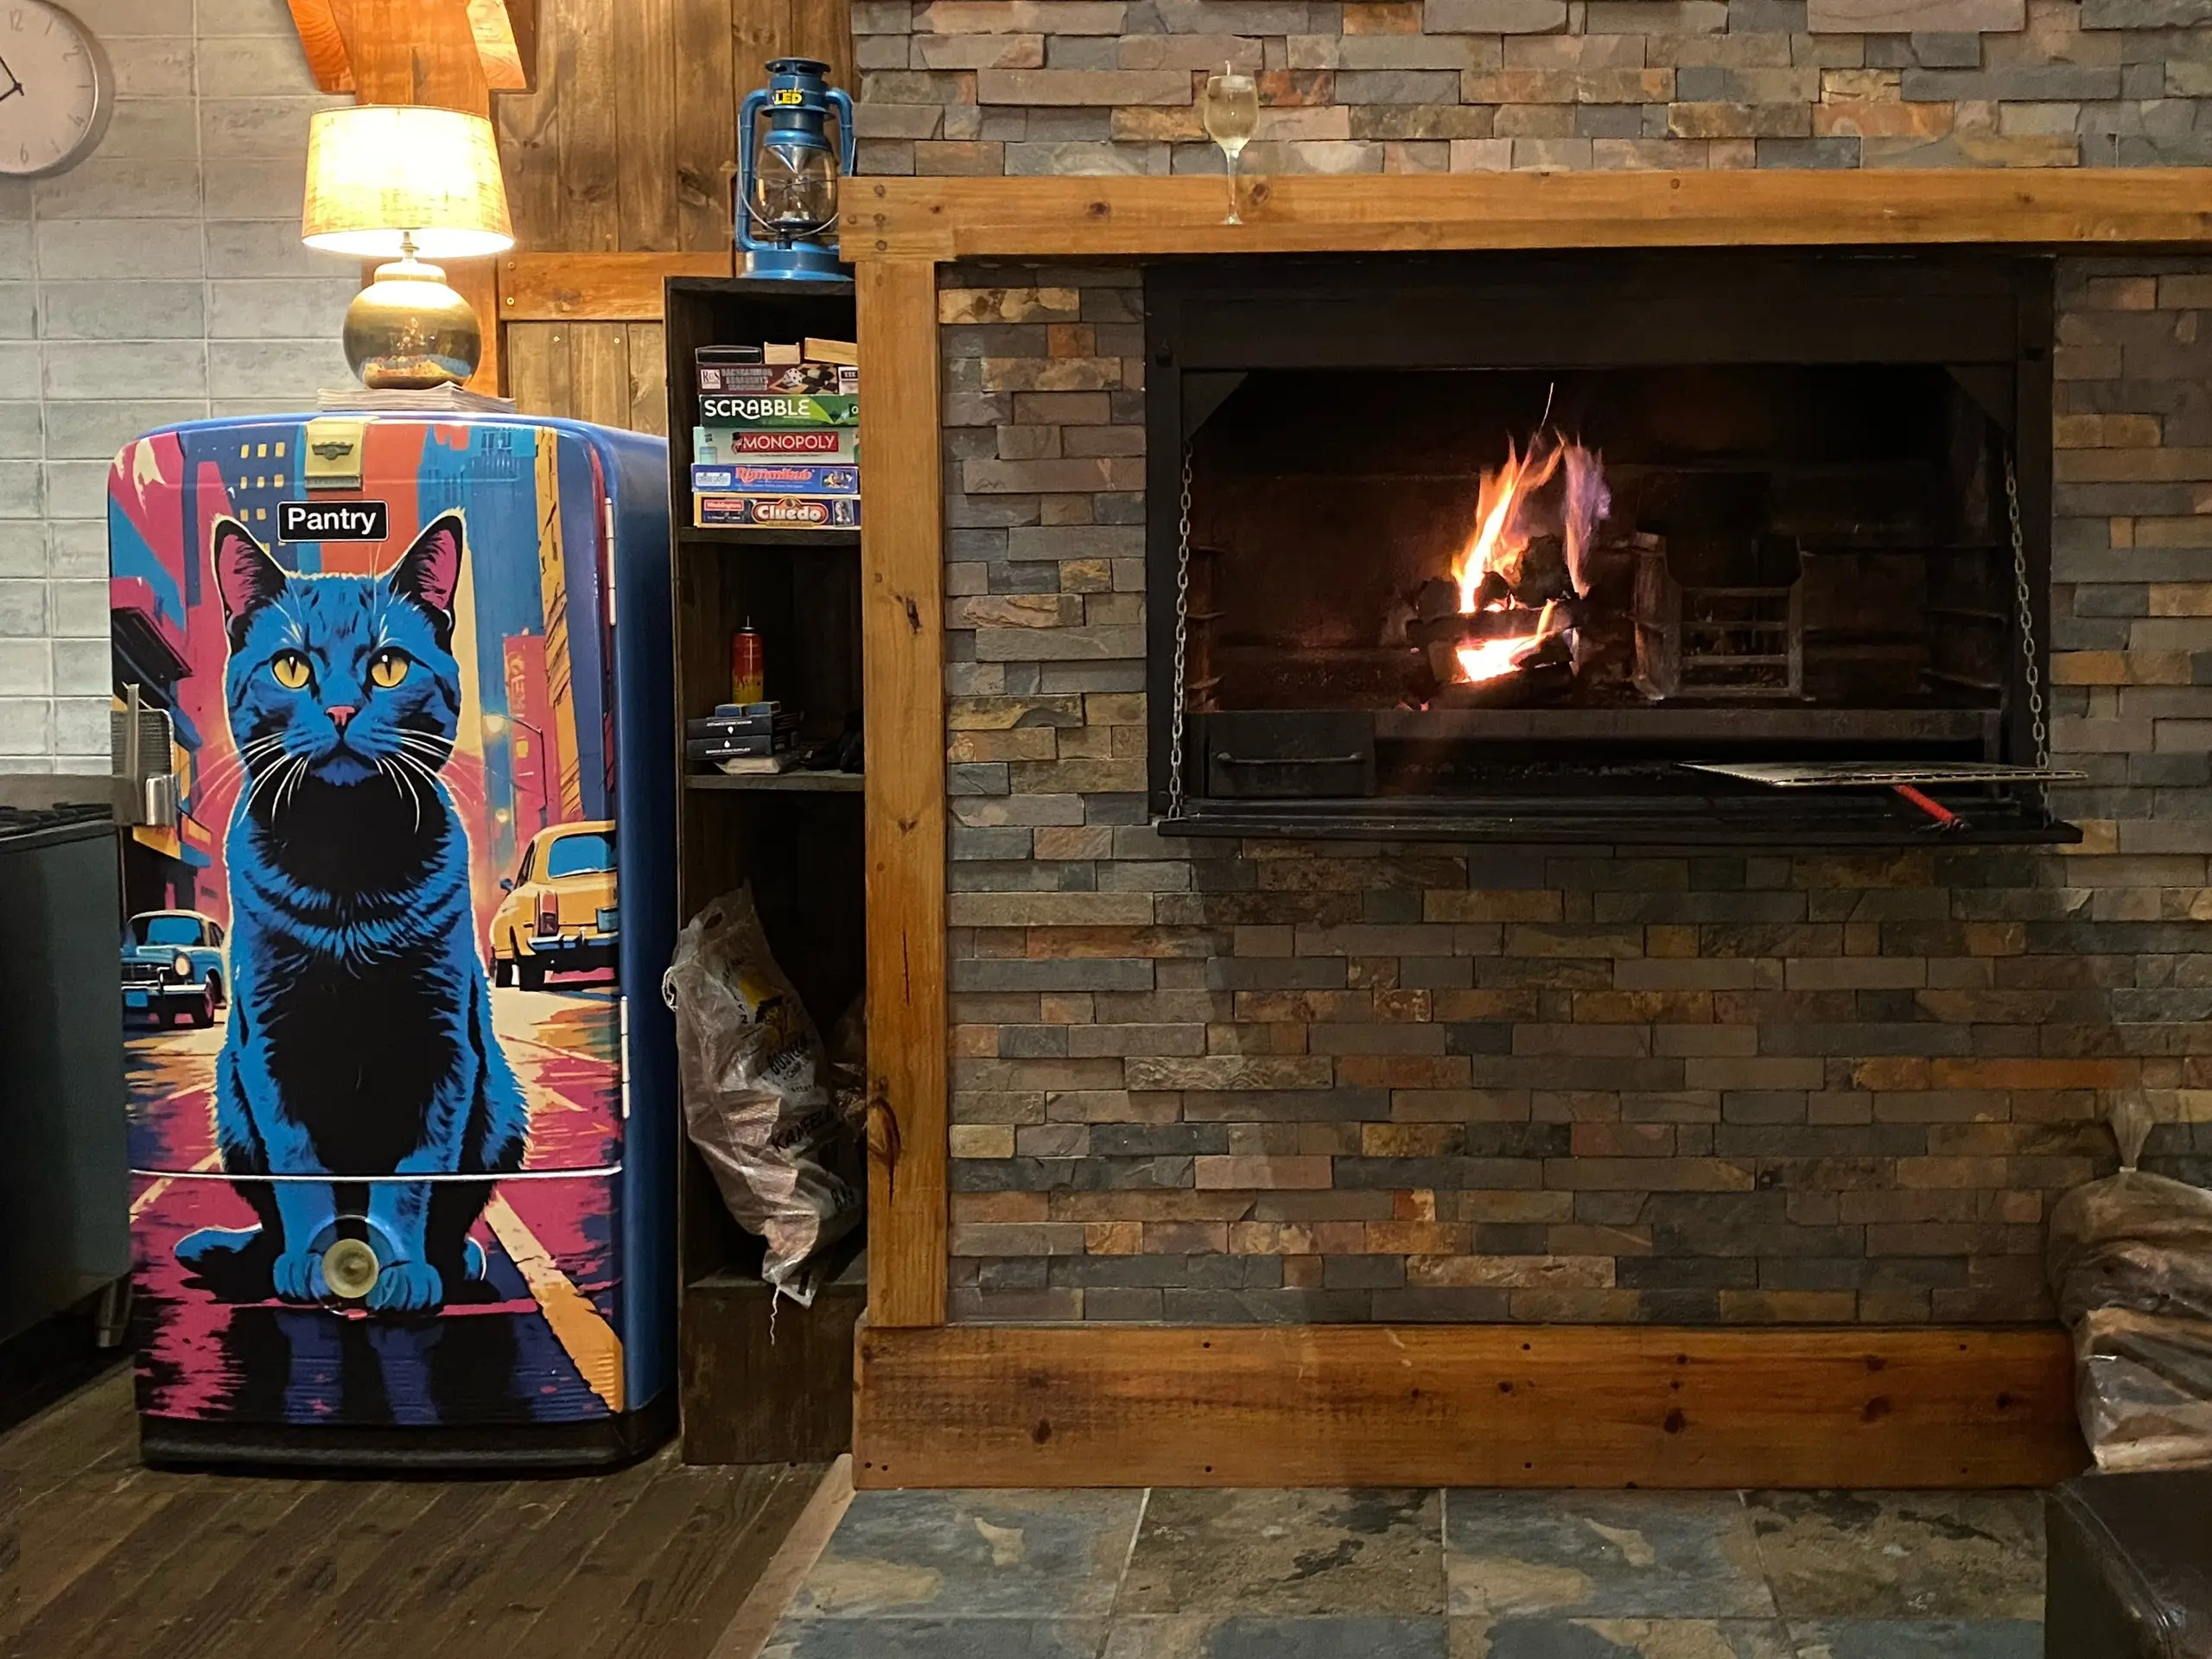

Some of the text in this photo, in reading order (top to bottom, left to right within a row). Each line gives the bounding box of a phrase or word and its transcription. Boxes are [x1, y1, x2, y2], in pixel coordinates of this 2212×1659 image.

[10, 10, 24, 33] 12
[774, 92, 803, 105] LED
[19, 143, 29, 165] 6
[704, 399, 810, 420] SCRABBLE
[743, 435, 835, 449] MONOPOLY
[287, 506, 377, 535] Pantry
[757, 503, 822, 521] Cluedo
